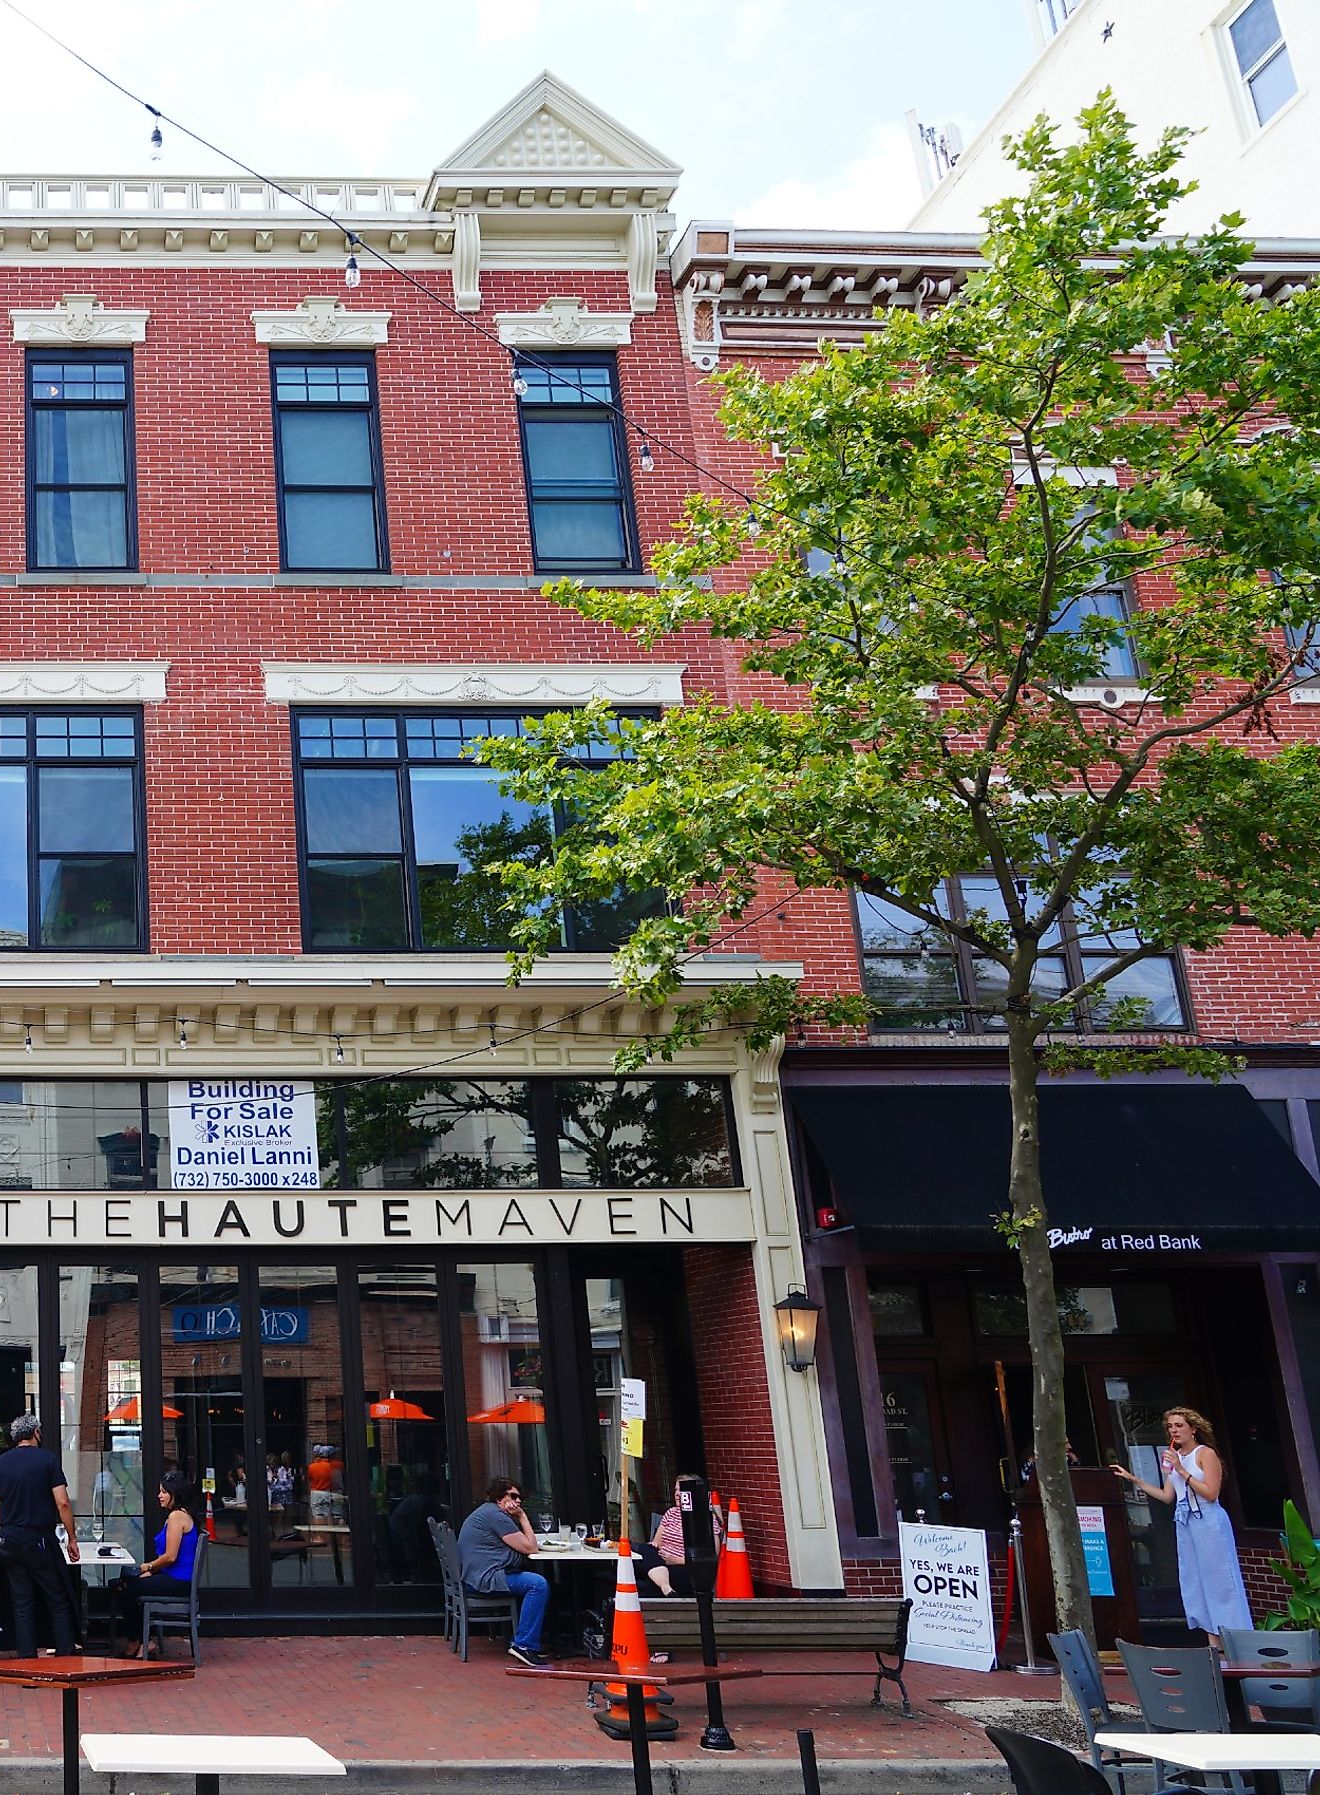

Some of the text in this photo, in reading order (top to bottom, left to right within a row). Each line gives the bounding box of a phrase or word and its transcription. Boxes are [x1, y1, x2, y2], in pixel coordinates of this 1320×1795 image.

[188, 1081, 294, 1102] Building
[191, 1103, 294, 1120] For Sale
[224, 1124, 292, 1138] KISLAK
[177, 1146, 312, 1165] Daniel Lanni
[174, 1172, 318, 1188] (732) 750-3000 x248
[1046, 1226, 1202, 1250] Bistro at Red Bank
[682, 1493, 690, 1504] B
[909, 1558, 980, 1577] YES, WE ARE
[914, 1574, 979, 1600] OPEN
[922, 1600, 973, 1612] PLEASE PRACTICE
